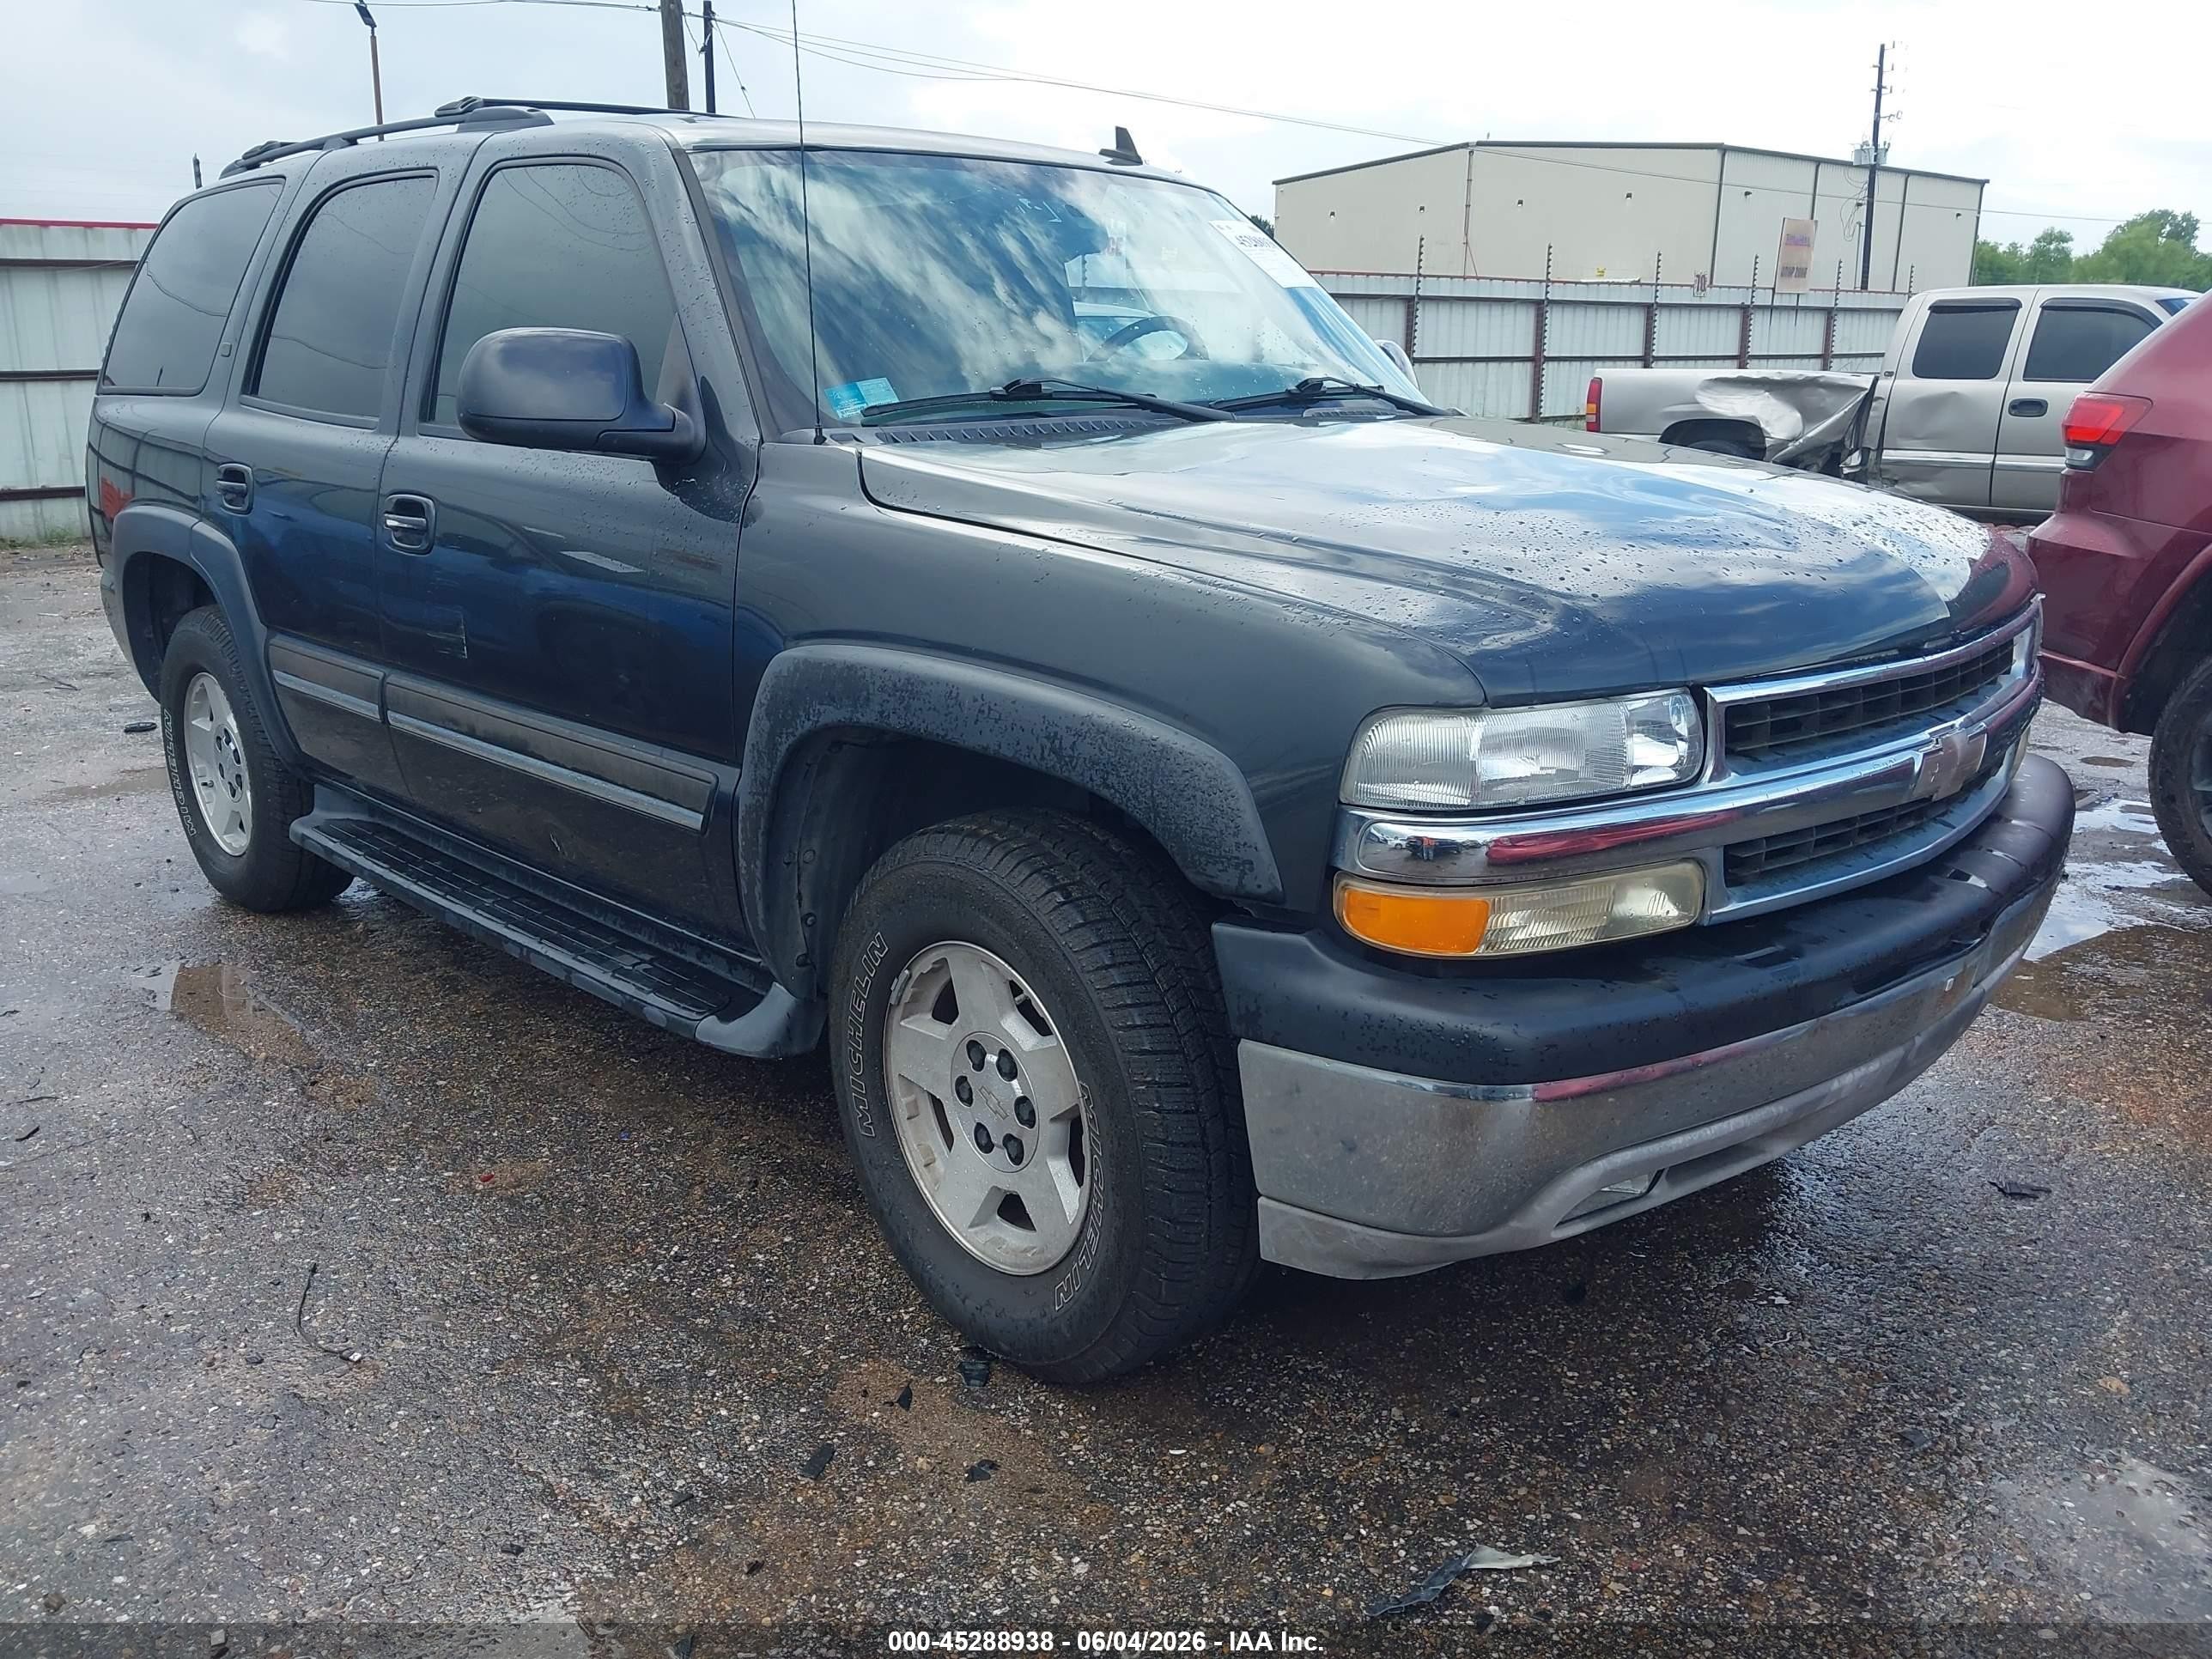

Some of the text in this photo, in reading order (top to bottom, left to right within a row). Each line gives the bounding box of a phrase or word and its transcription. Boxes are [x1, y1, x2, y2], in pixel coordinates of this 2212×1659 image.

[164, 708, 197, 836] MICHELIN
[847, 932, 888, 1137] MICHELIN
[1054, 1080, 1104, 1310] MICHELIN
